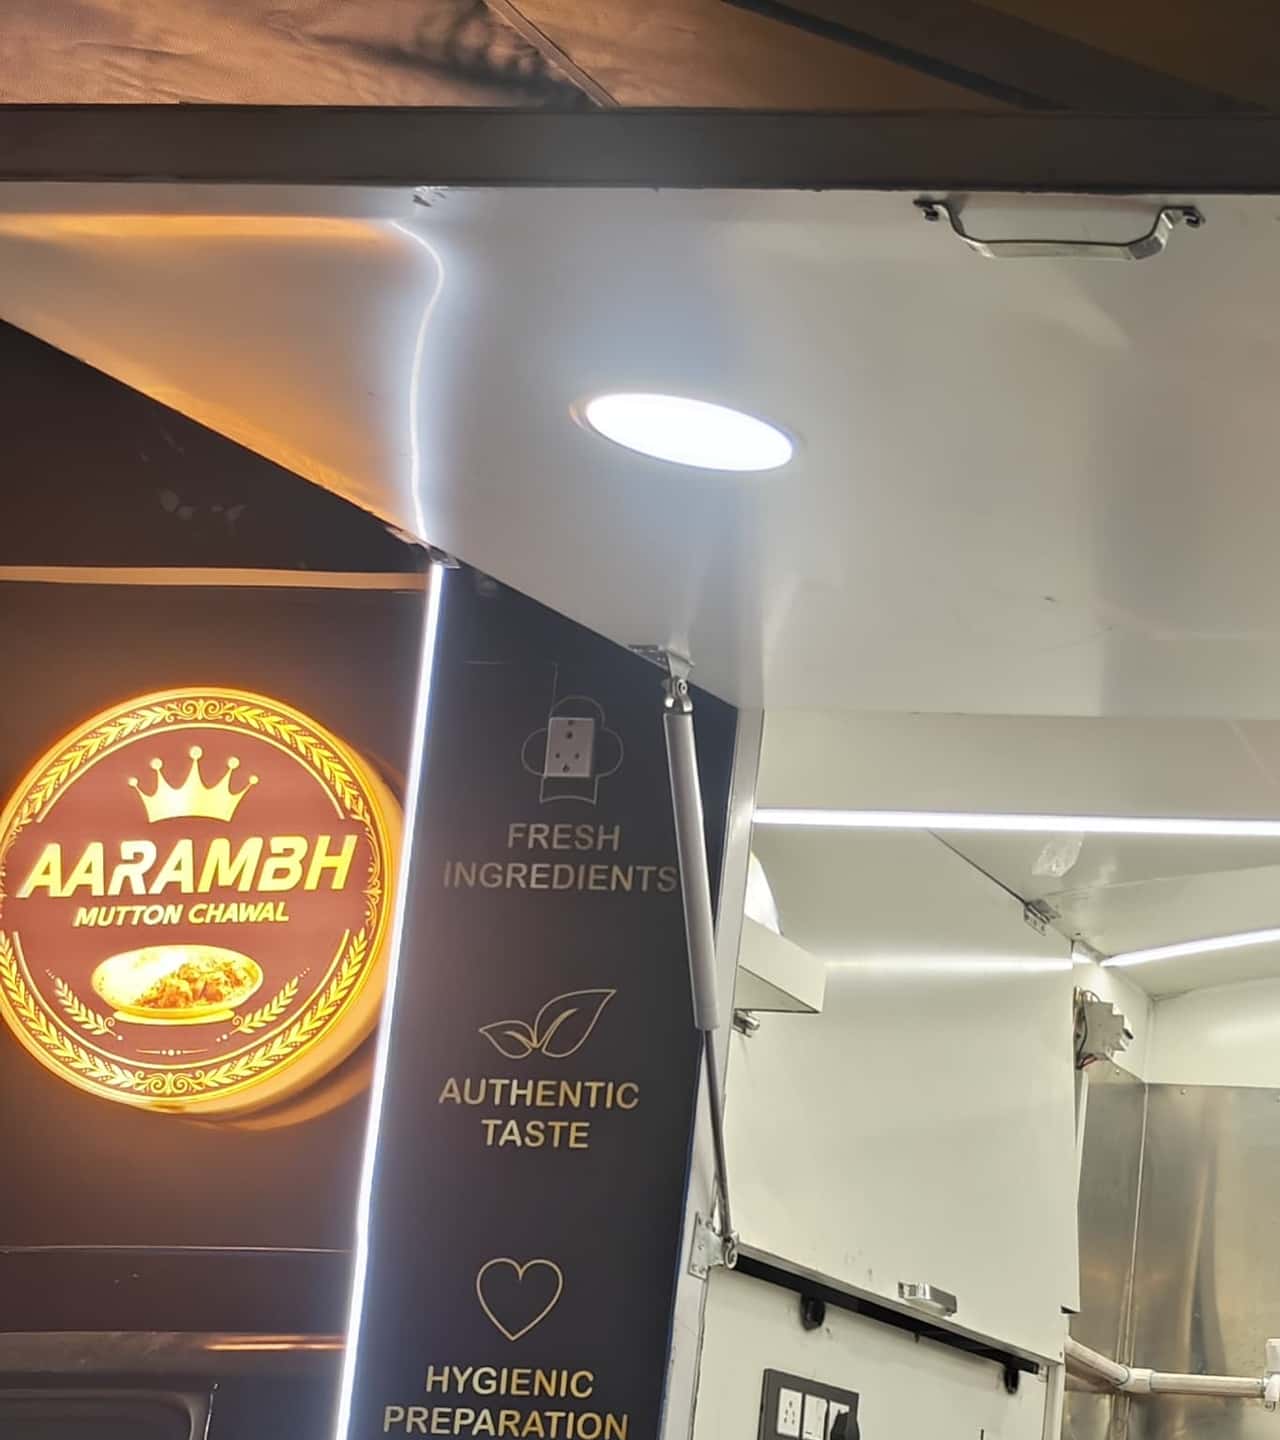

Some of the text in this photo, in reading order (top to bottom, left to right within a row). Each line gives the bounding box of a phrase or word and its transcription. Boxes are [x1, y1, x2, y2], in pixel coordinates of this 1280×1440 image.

[507, 823, 621, 852] FRESH
[16, 834, 358, 899] AARAMBH
[442, 860, 679, 893] INGREDIENTS
[73, 899, 289, 927] MUTTON CHAWAL
[439, 1078, 640, 1109] AUTHENTIC
[481, 1119, 590, 1149] TASTE
[426, 1365, 594, 1398] HYGIENIC
[383, 1406, 628, 1440] PREPARATION
